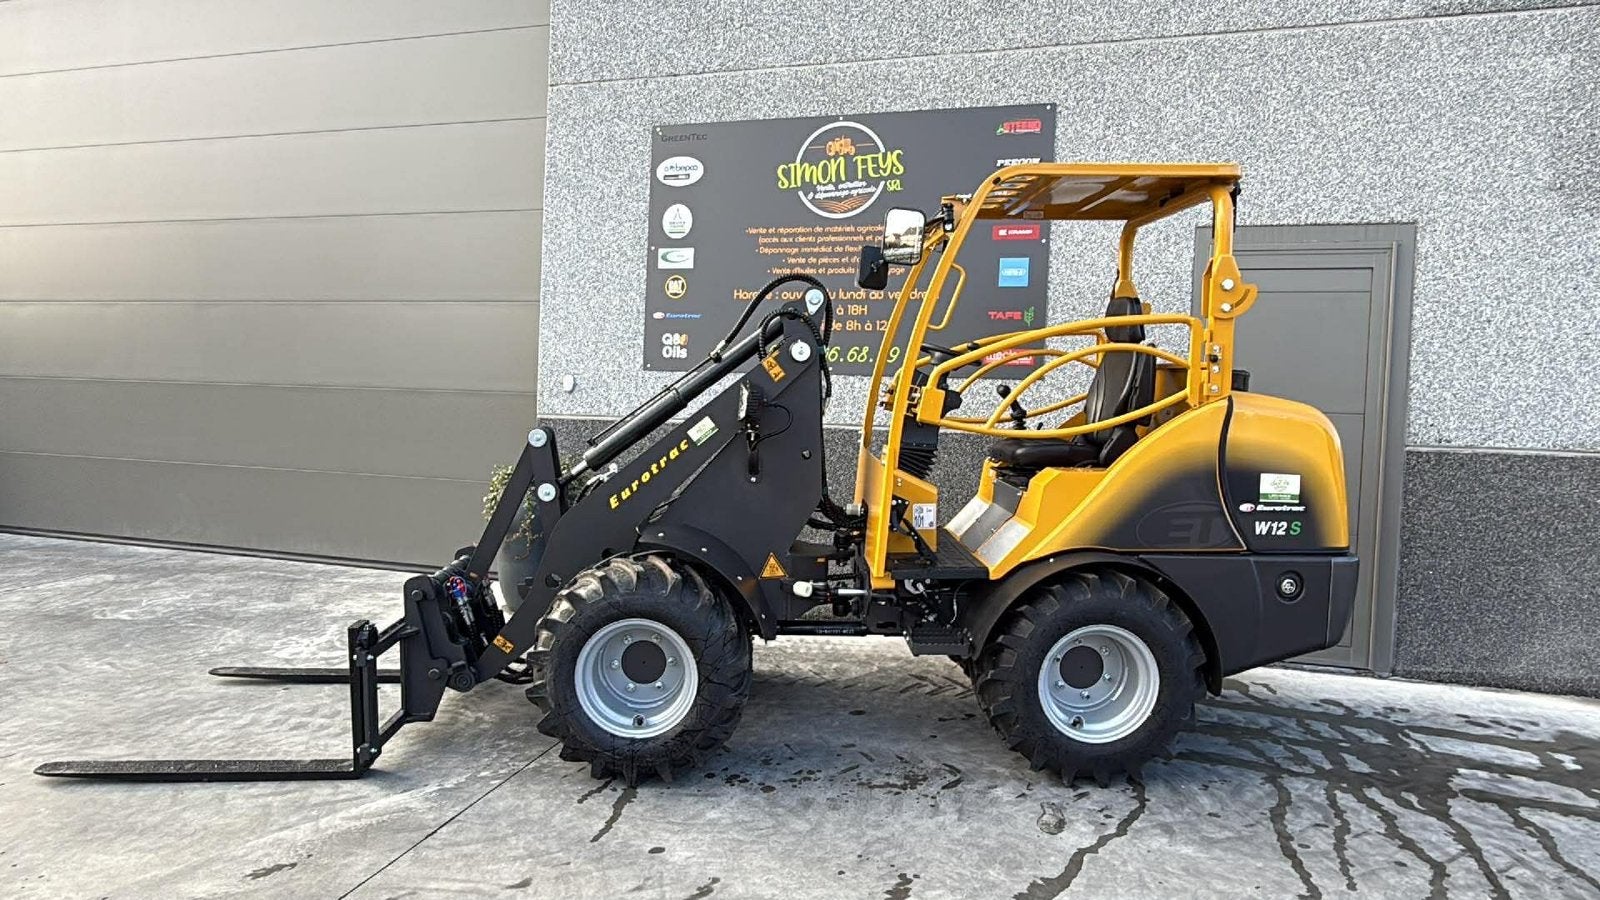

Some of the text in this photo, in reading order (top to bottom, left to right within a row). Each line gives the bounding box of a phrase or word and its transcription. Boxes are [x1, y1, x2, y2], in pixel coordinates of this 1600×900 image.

[777, 149, 904, 189] SIMON FEYS
[795, 235, 816, 243] clients
[817, 234, 864, 243] professionnels
[828, 266, 855, 275] produits
[839, 288, 867, 300] lundi
[869, 290, 884, 300] au
[848, 304, 868, 316] 18H
[988, 311, 1022, 321] TAFE
[846, 319, 861, 331] 8h
[864, 320, 873, 331] à
[661, 332, 681, 346] Q8
[662, 345, 688, 358] Oils
[609, 438, 690, 510] Eurotrac
[1256, 504, 1306, 512] Eurotrac
[1254, 521, 1302, 536] W12 S
